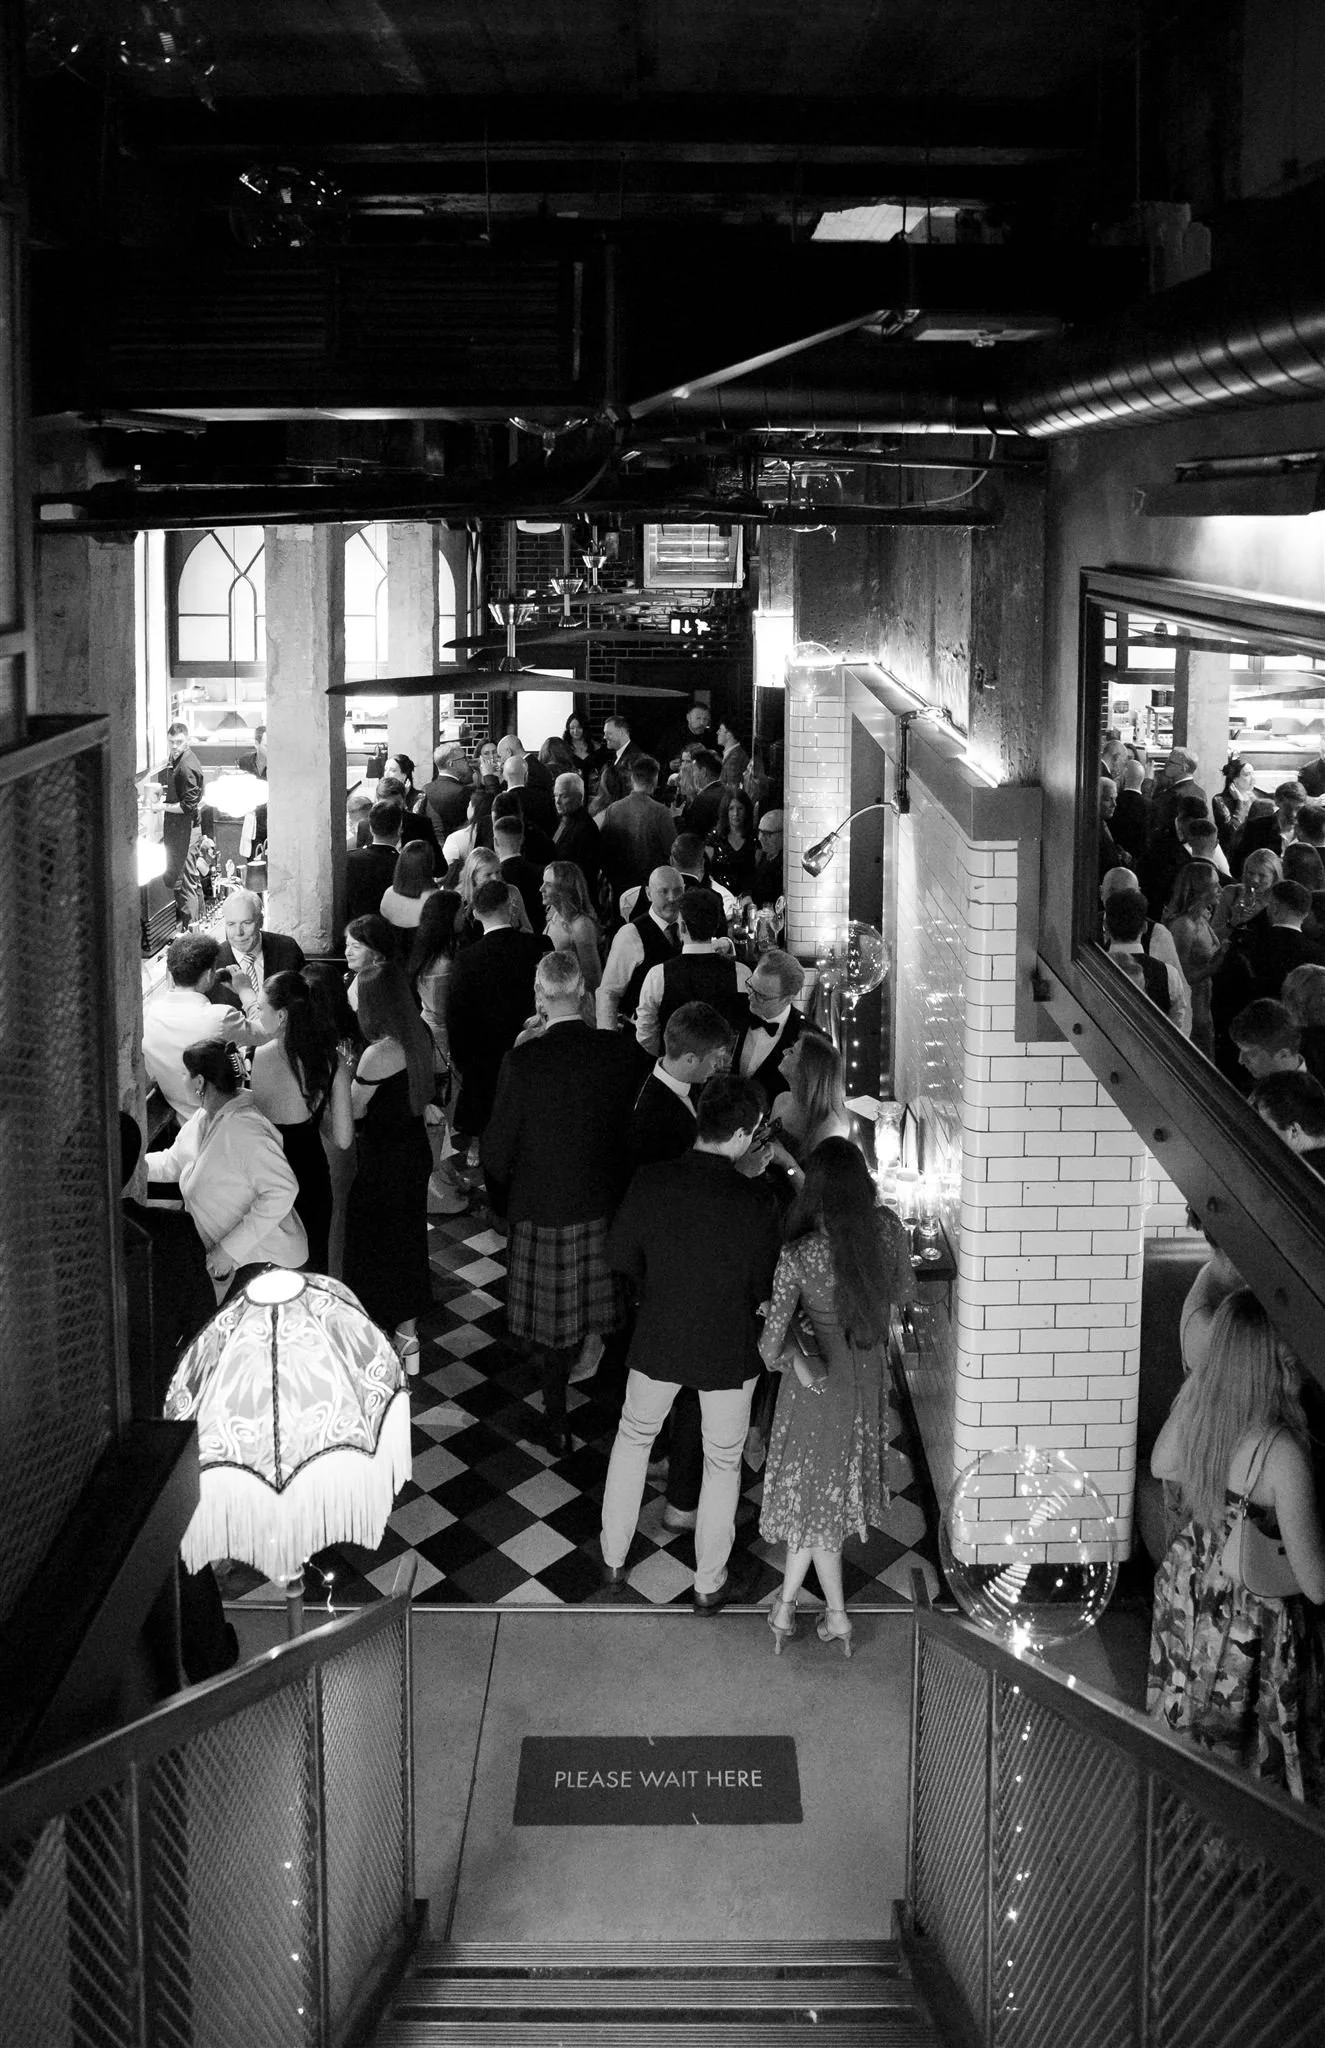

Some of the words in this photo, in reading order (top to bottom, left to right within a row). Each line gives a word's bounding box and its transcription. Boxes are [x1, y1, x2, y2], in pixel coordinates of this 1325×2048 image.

[554, 1771, 632, 1788] PLEASE
[639, 1770, 699, 1788] WAIT
[707, 1770, 763, 1788] HERE
